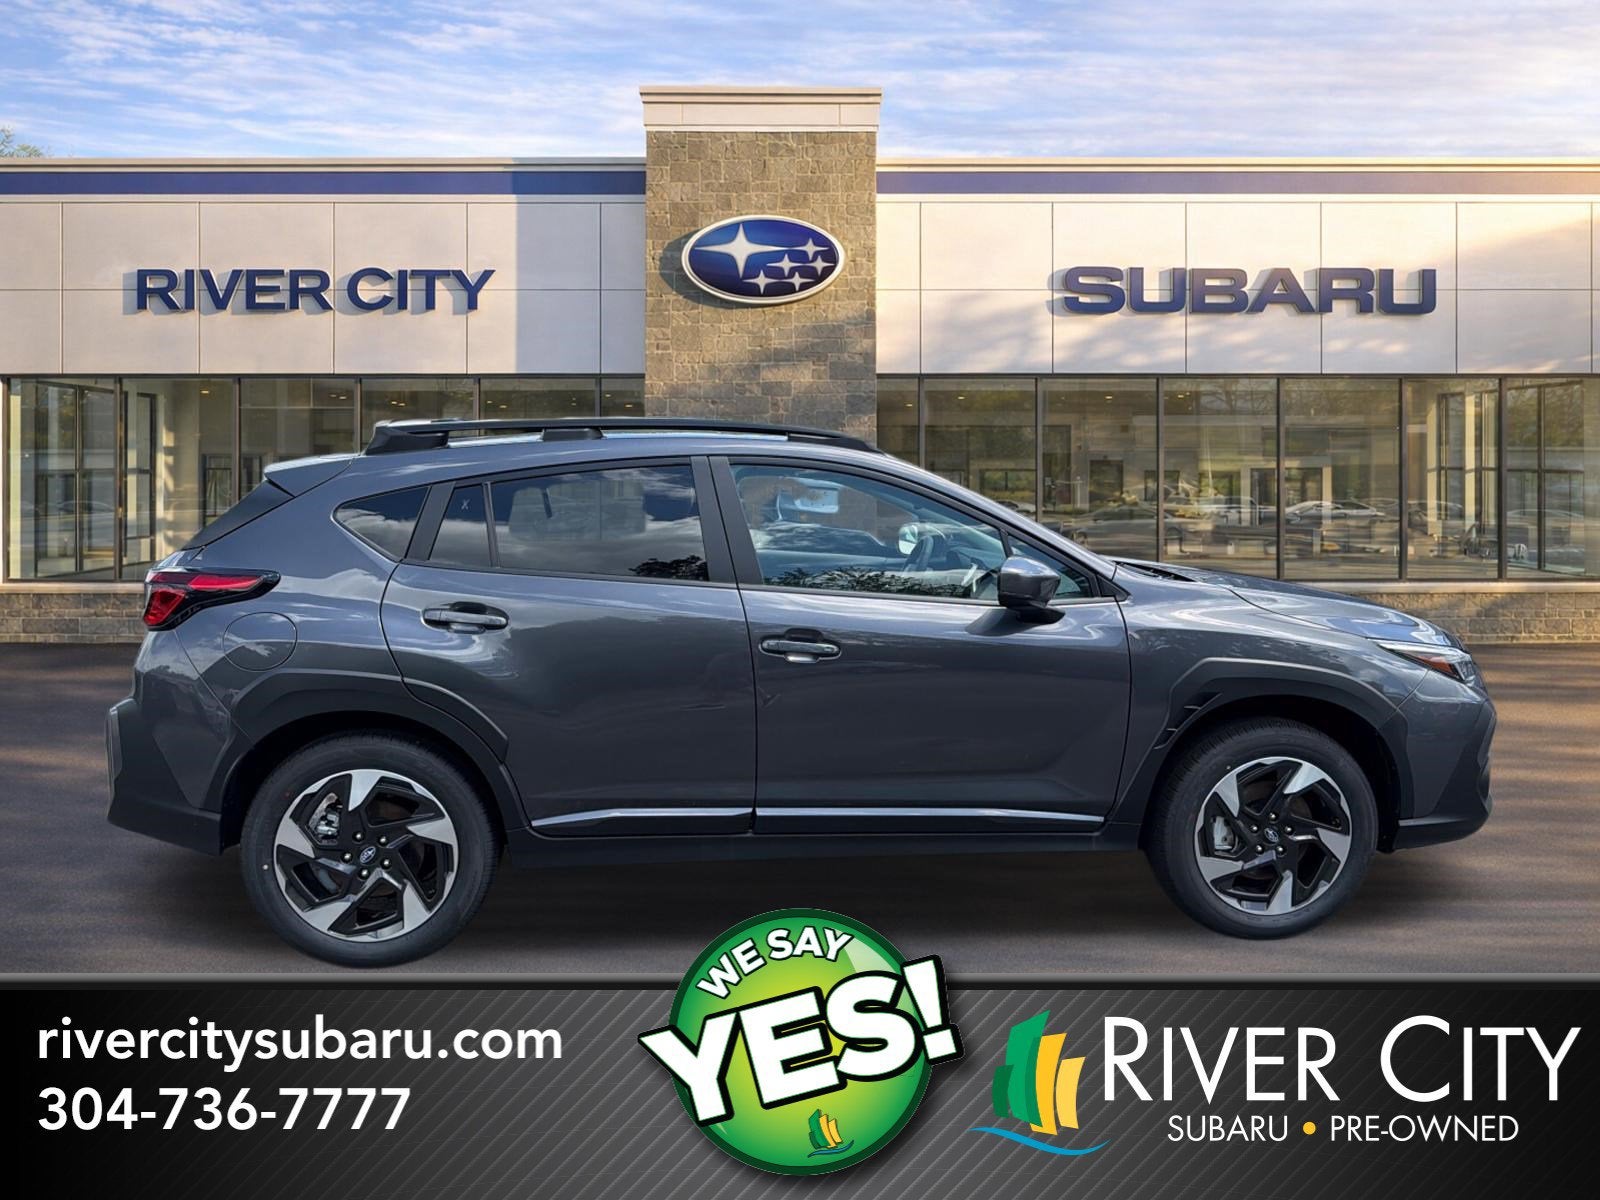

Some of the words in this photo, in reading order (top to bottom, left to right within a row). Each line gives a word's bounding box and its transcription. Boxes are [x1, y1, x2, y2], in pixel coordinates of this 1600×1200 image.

[136, 268, 333, 312] RIVER
[346, 267, 496, 312] CITY
[1062, 266, 1437, 315] SUBARU
